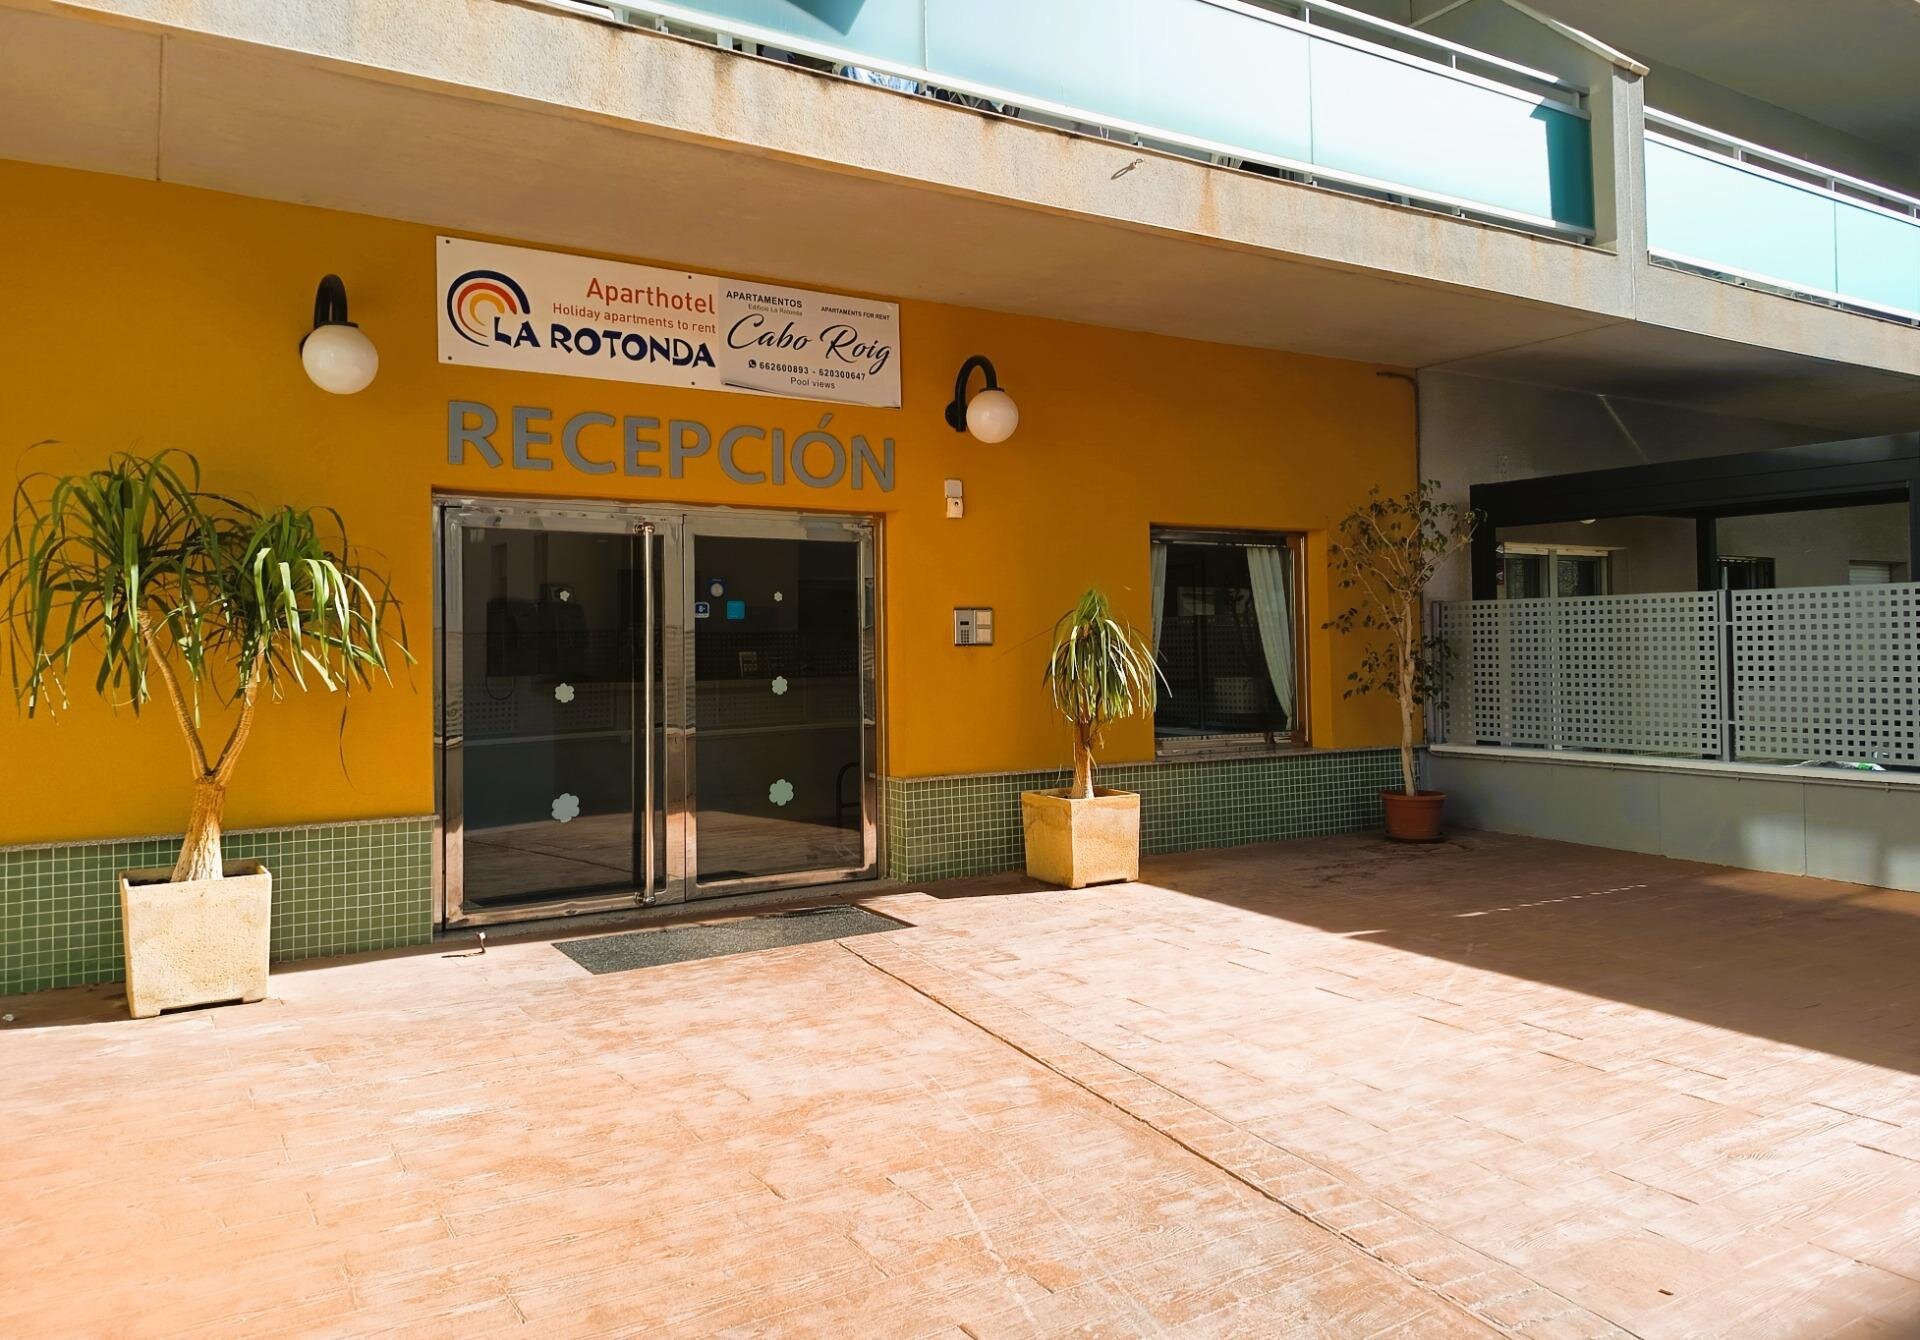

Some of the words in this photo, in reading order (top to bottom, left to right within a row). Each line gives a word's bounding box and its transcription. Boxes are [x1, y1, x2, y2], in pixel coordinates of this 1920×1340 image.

[586, 277, 716, 315] Aparthotel
[726, 290, 803, 309] APARTAMENTOS
[553, 302, 601, 322] Holiday
[603, 312, 674, 329] apartments
[677, 319, 689, 331] to
[692, 323, 717, 334] rent
[863, 311, 875, 319] FOR
[875, 313, 890, 321] RENT
[494, 316, 541, 349] LA
[550, 323, 716, 369] ROTONDA
[727, 313, 813, 351] Cabo
[819, 324, 892, 376] Roig
[759, 361, 809, 375] 662600893
[790, 376, 810, 386] Pool
[812, 380, 836, 390] views
[447, 400, 896, 493] RECEPCIÓN
